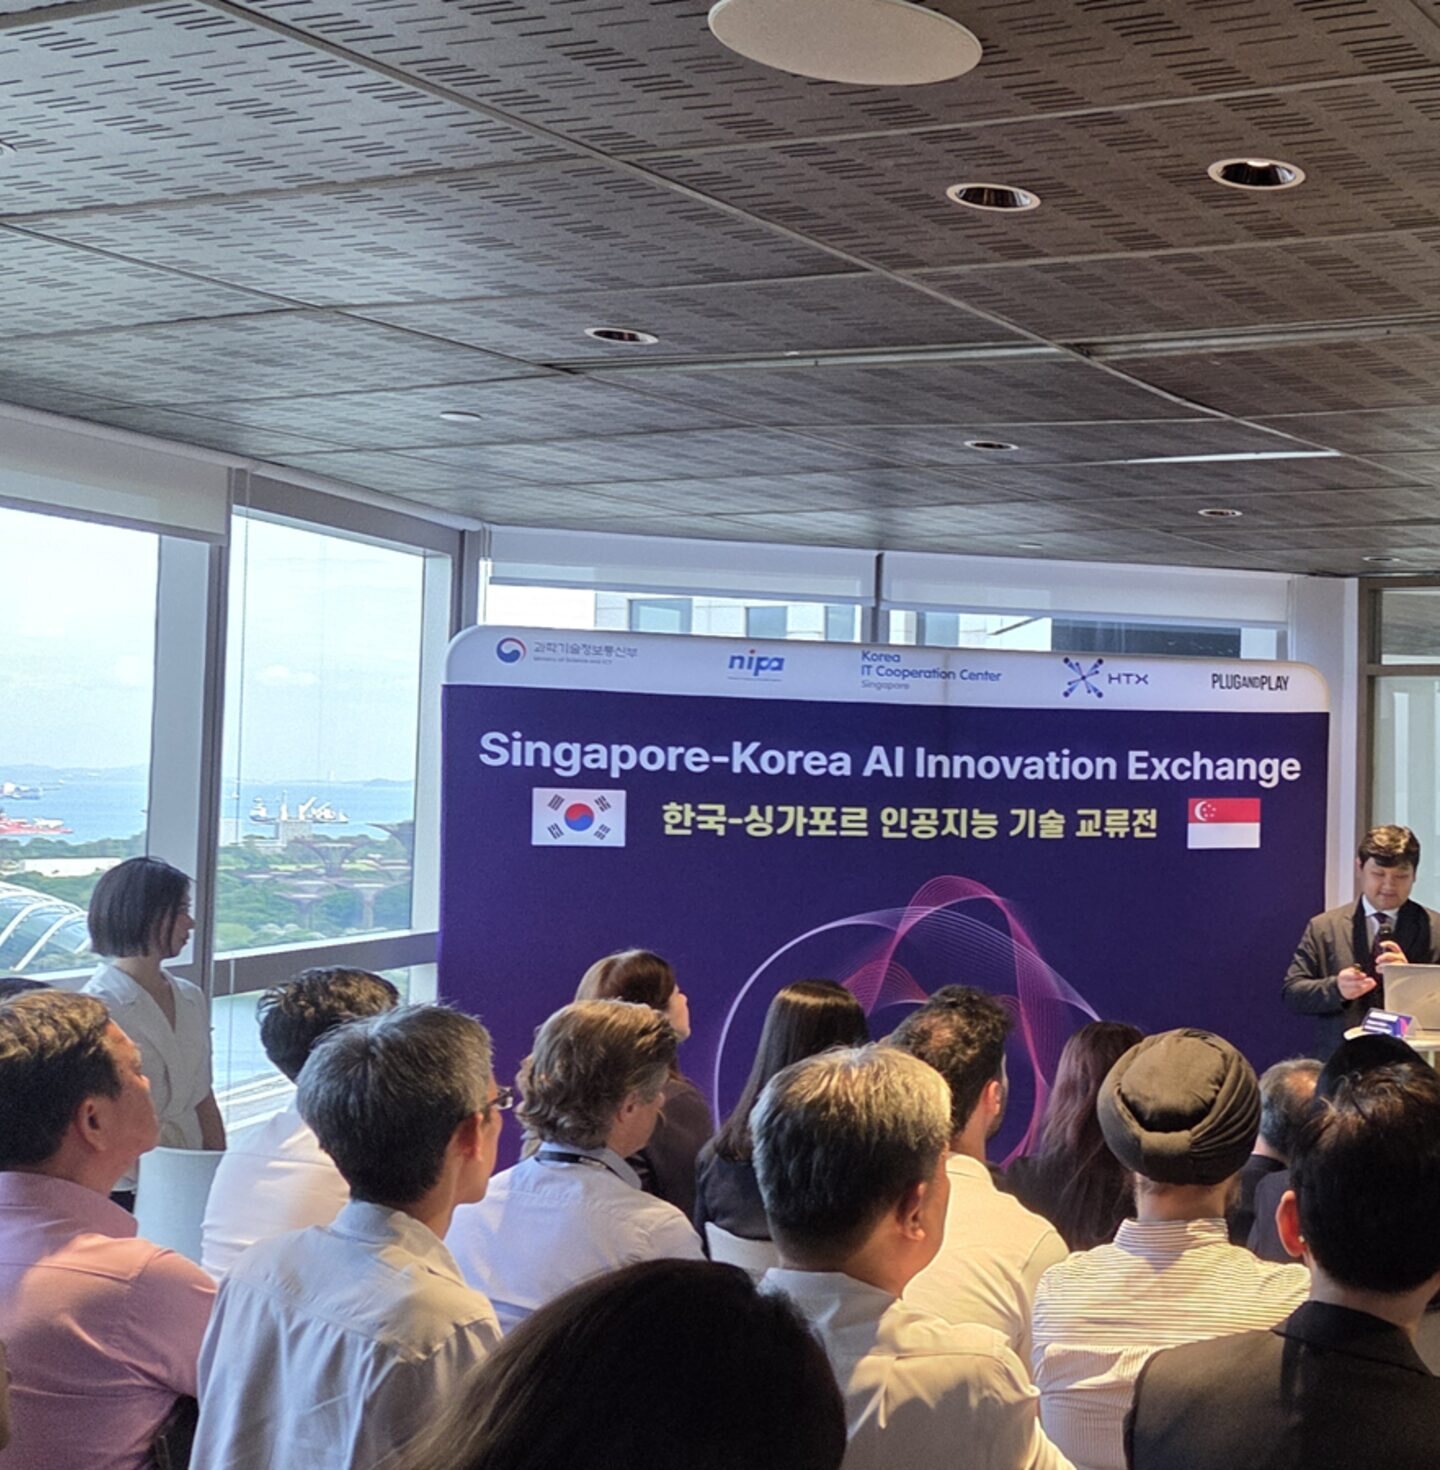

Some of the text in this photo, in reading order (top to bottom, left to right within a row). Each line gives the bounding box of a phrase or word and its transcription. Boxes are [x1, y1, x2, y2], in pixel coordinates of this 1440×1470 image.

[534, 641, 638, 658] 과학기술정보통신부
[861, 651, 901, 663] Korea
[729, 649, 784, 676] nipa
[861, 665, 1002, 682] IT Cooperation Center
[1108, 673, 1149, 686] HTX
[861, 680, 910, 691] Singapore
[479, 731, 1301, 788] Singapore-Korea AI Innovation Exchange
[661, 801, 1157, 839] 한국-싱가포르 인공지능 기술 교류전
